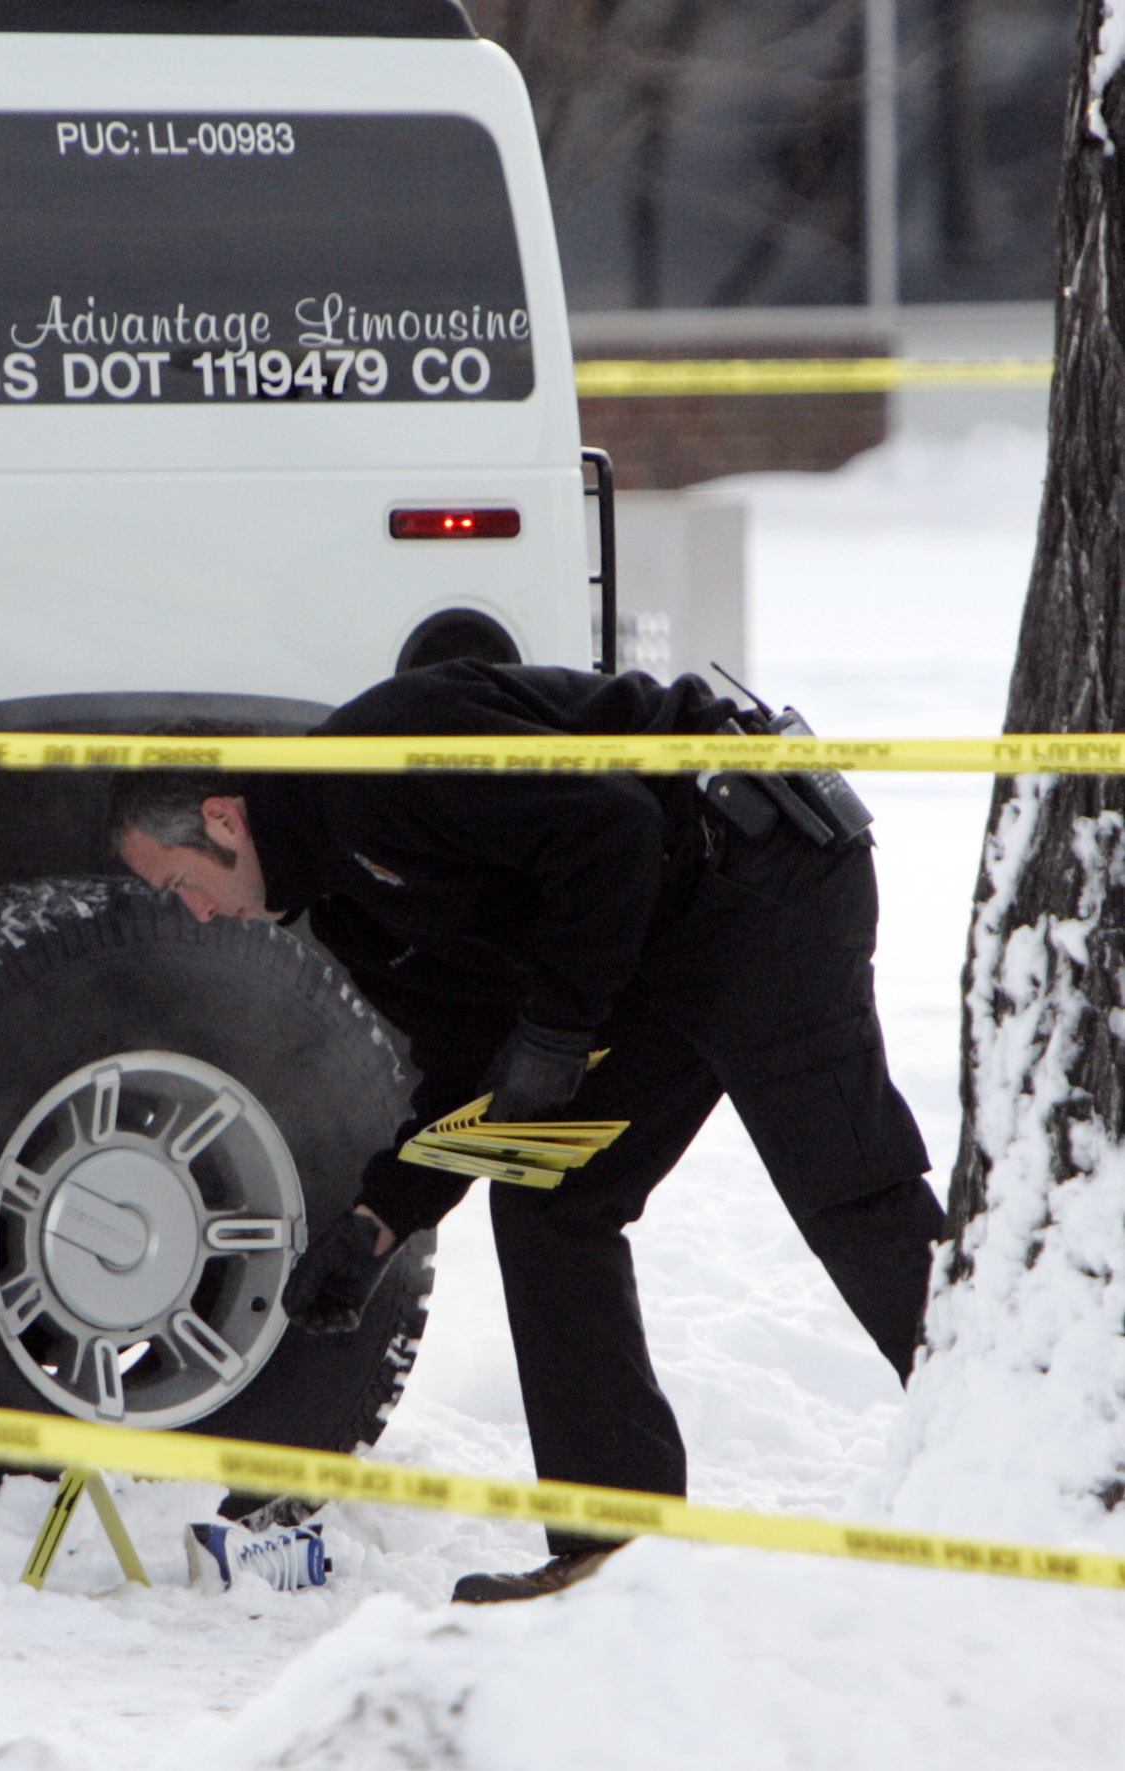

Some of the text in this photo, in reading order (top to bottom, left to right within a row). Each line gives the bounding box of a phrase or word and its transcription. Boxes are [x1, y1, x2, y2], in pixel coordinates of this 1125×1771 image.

[56, 122, 295, 156] PUC: LL-00983
[10, 295, 271, 358] Advantage
[295, 292, 529, 349] Limousine
[63, 351, 170, 398] DOT
[193, 349, 388, 397] 1119479
[412, 347, 491, 394] CO
